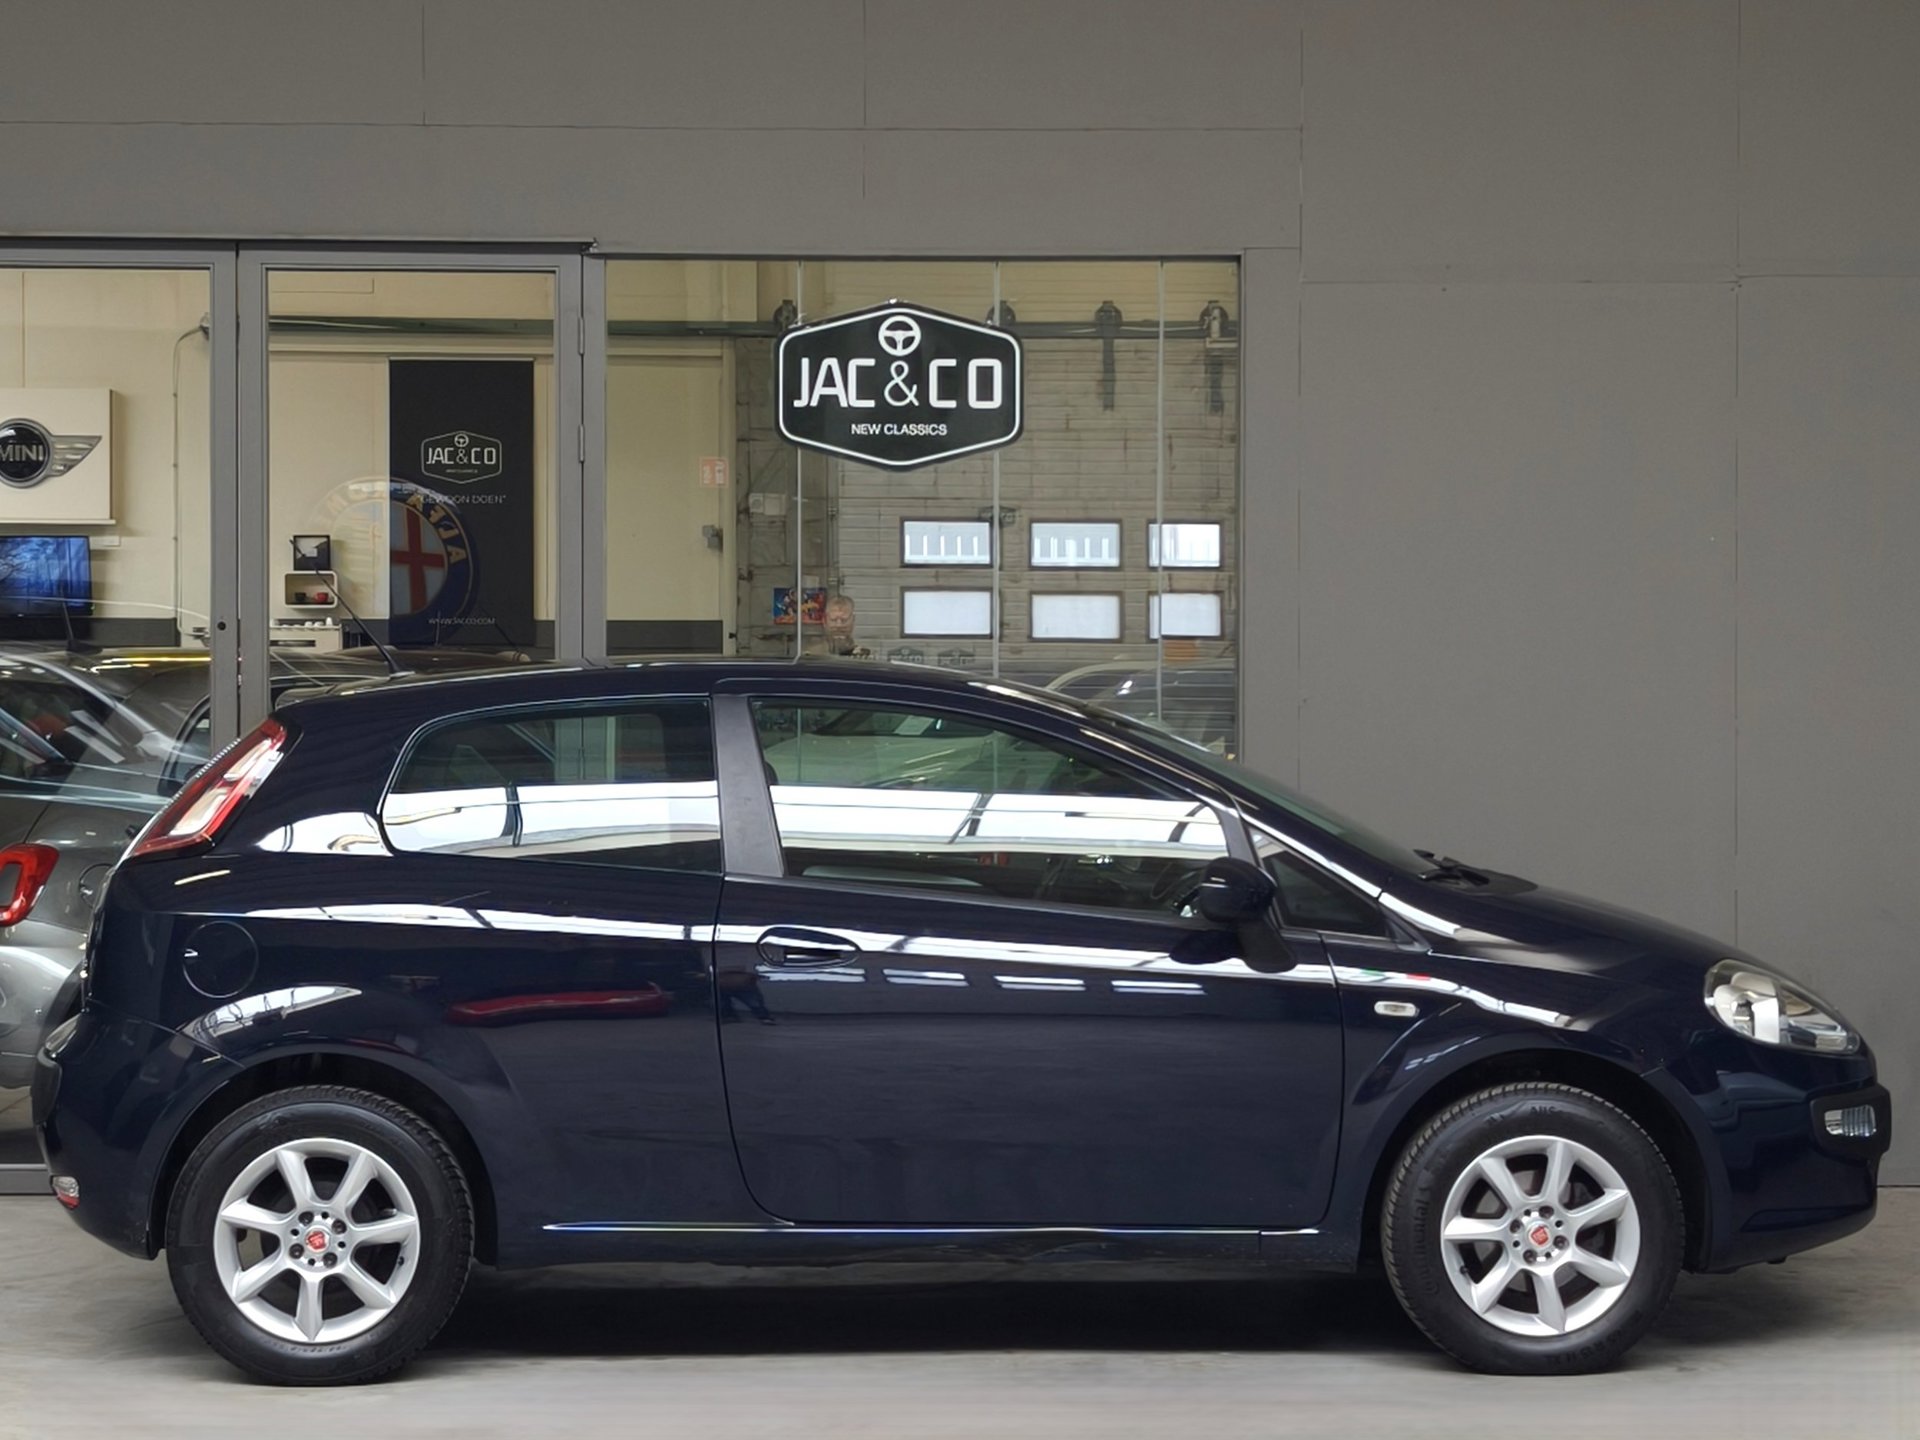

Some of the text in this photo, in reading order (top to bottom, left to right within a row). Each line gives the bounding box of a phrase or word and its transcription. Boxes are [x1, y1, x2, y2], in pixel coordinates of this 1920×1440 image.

[851, 424, 947, 435] NEW CLASSICS
[0, 444, 44, 461] MINI
